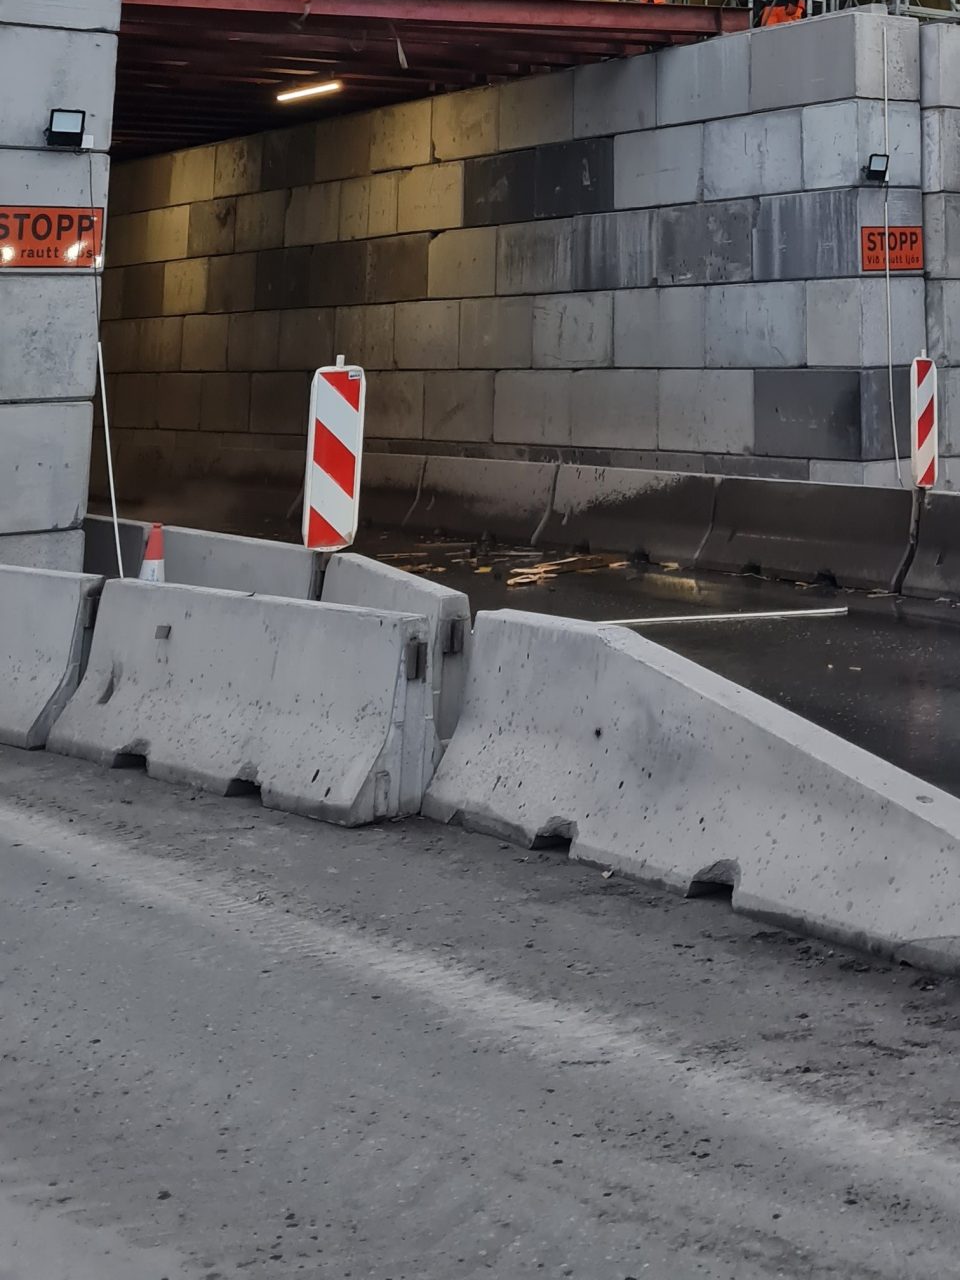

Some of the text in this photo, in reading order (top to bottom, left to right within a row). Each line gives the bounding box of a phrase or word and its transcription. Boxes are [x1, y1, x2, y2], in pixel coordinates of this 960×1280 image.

[0, 213, 94, 241] STOPP
[867, 231, 919, 252] STOPP
[21, 246, 60, 259] rautt
